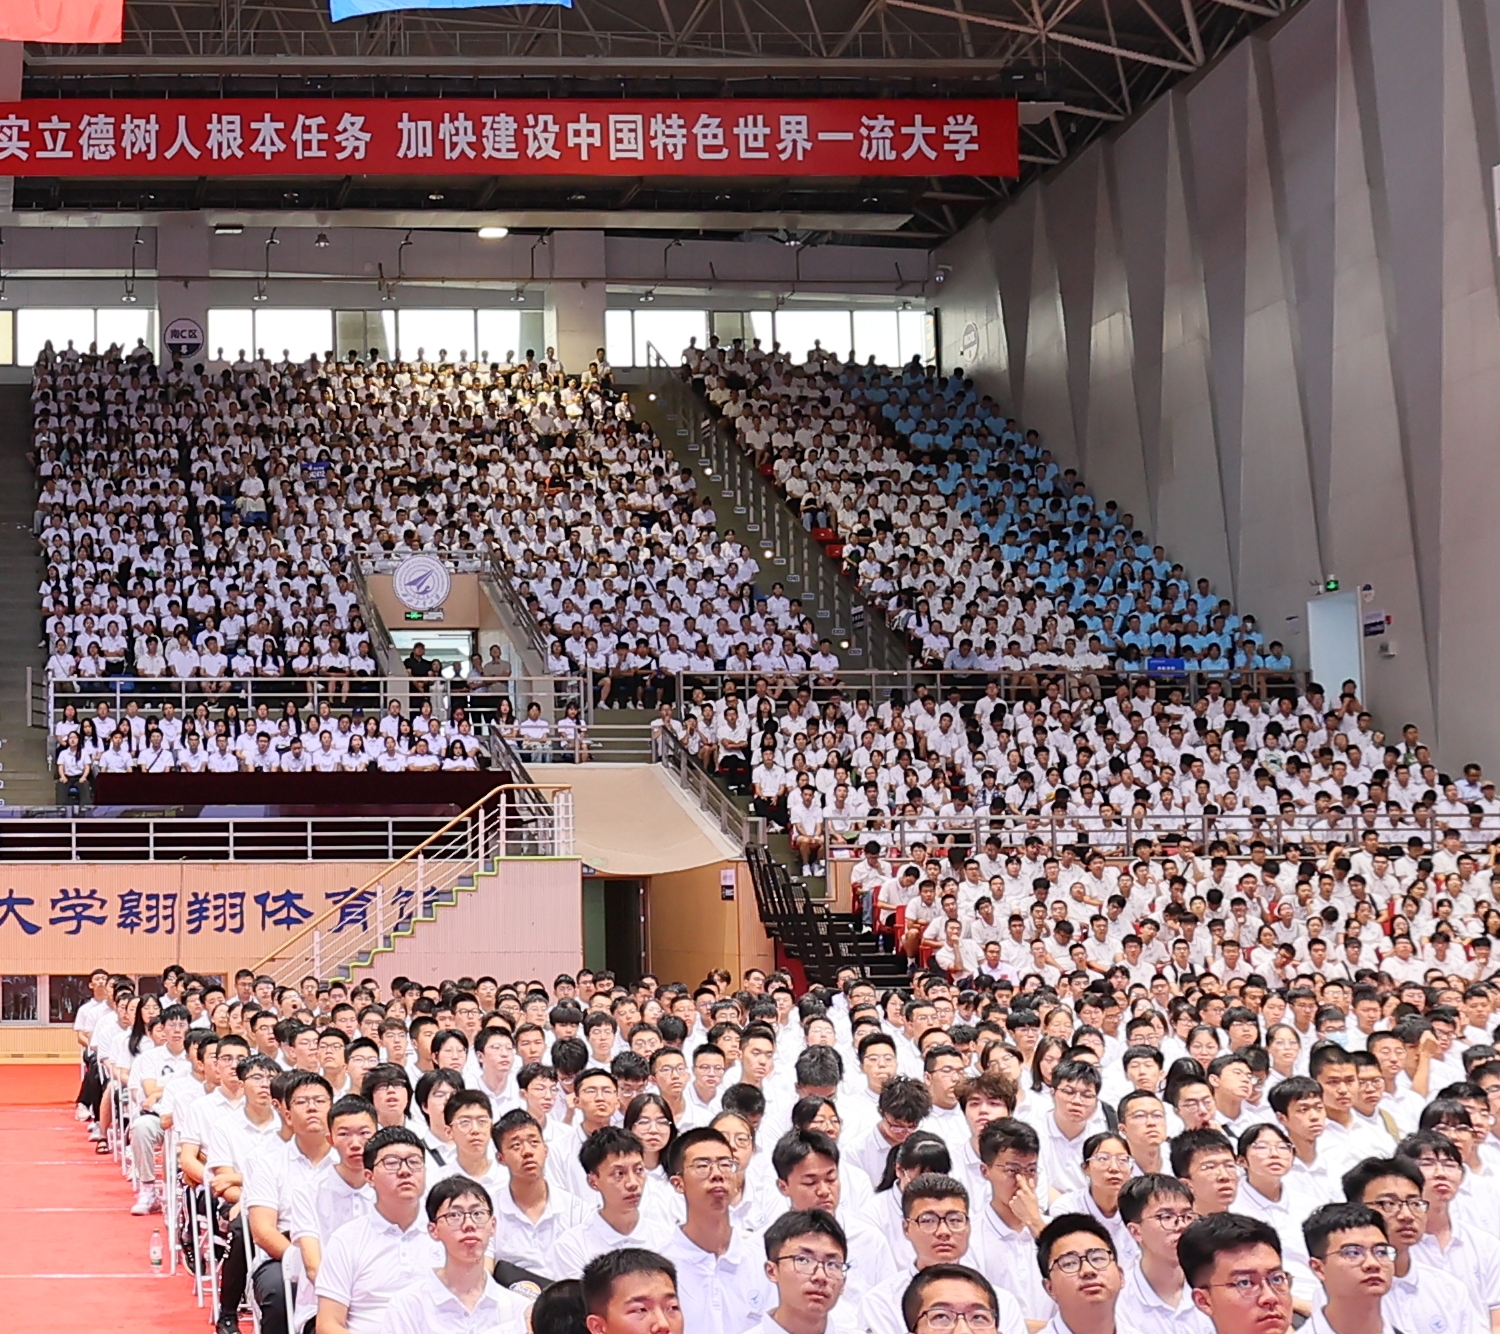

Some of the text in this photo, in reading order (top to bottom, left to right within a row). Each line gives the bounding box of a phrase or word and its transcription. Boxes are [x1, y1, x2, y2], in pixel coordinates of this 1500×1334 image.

[397, 112, 980, 161] 加快建设中国特色世界一流大学
